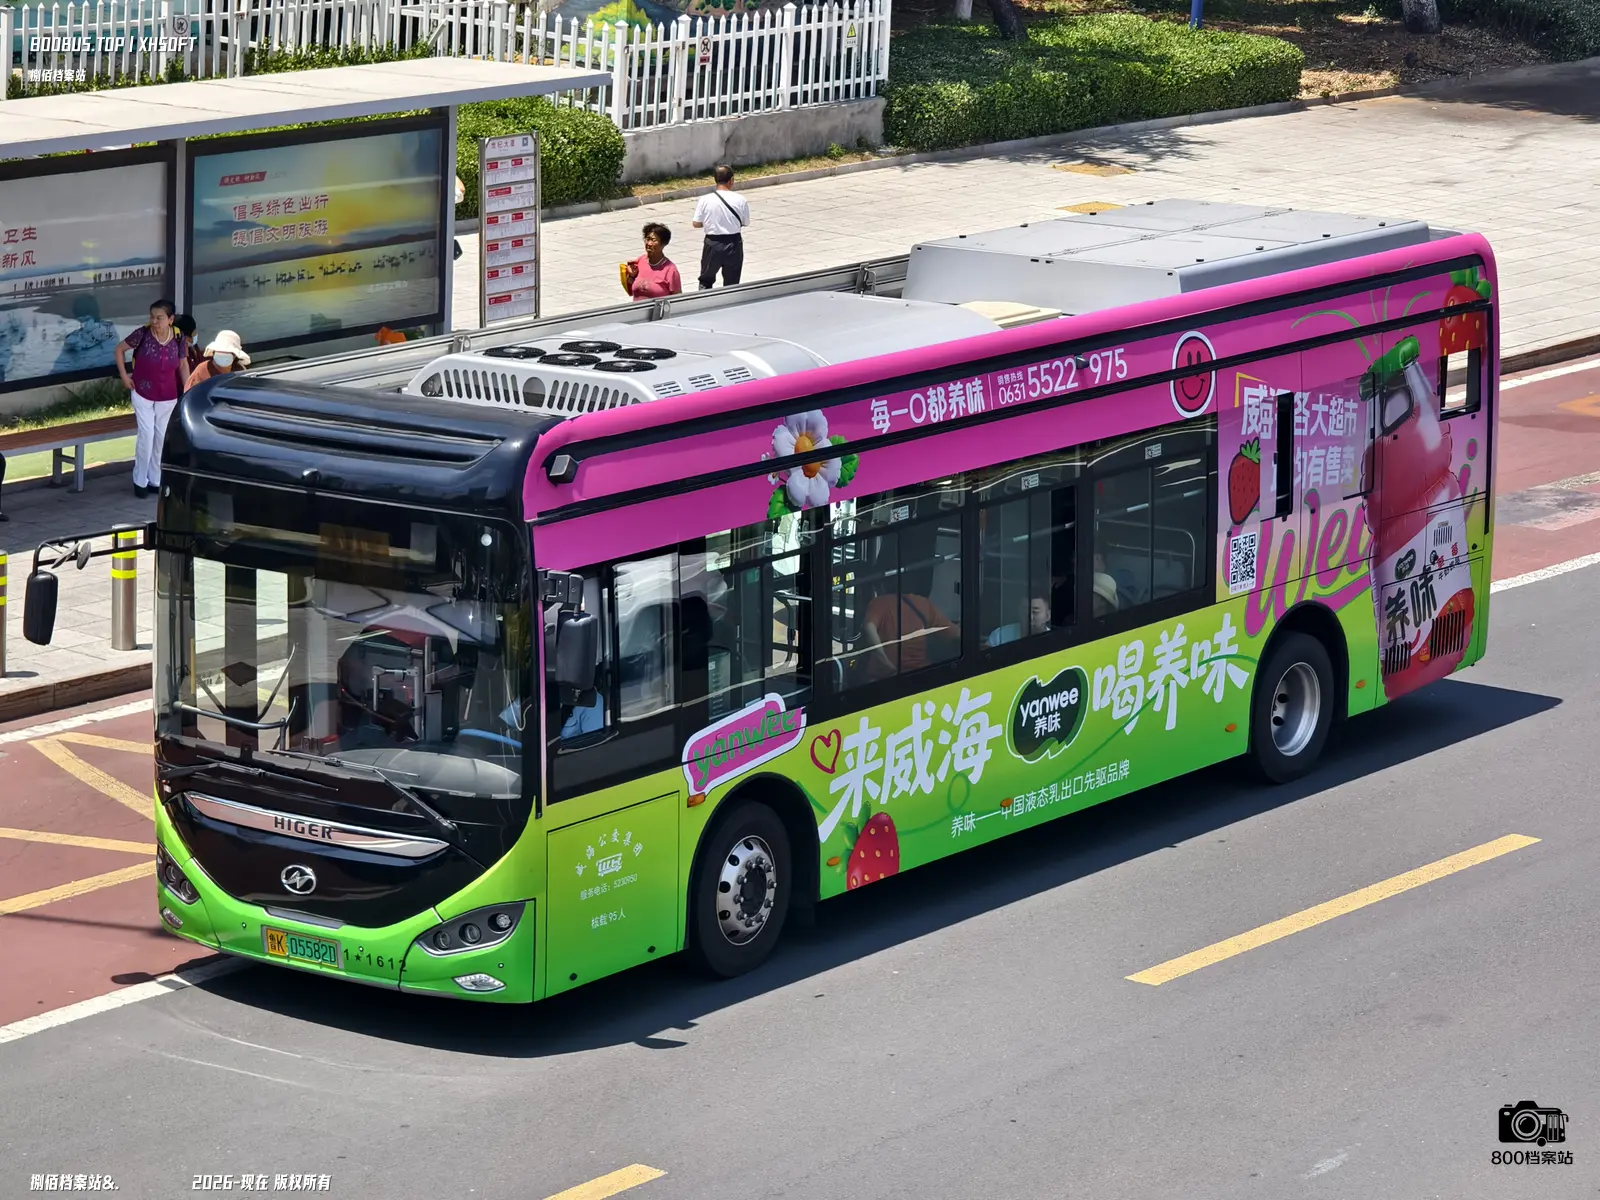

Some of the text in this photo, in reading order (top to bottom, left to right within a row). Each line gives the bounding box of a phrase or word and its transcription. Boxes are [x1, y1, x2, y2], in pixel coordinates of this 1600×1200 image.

[233, 194, 329, 220] 倡导绿色出行
[3, 225, 38, 245] 卫生
[232, 219, 329, 247] 提倡文明旅游
[2, 250, 37, 269] 新风
[997, 371, 1024, 386] 销售热线
[999, 382, 1026, 405] 0631
[1241, 384, 1358, 440] 威各大超市
[1092, 613, 1249, 734] 喝养味
[1020, 687, 1079, 727] yanwee
[1034, 711, 1061, 738] 养味
[693, 709, 797, 786] yanwee
[818, 686, 1003, 842] 来威海
[274, 816, 333, 840] HIGER
